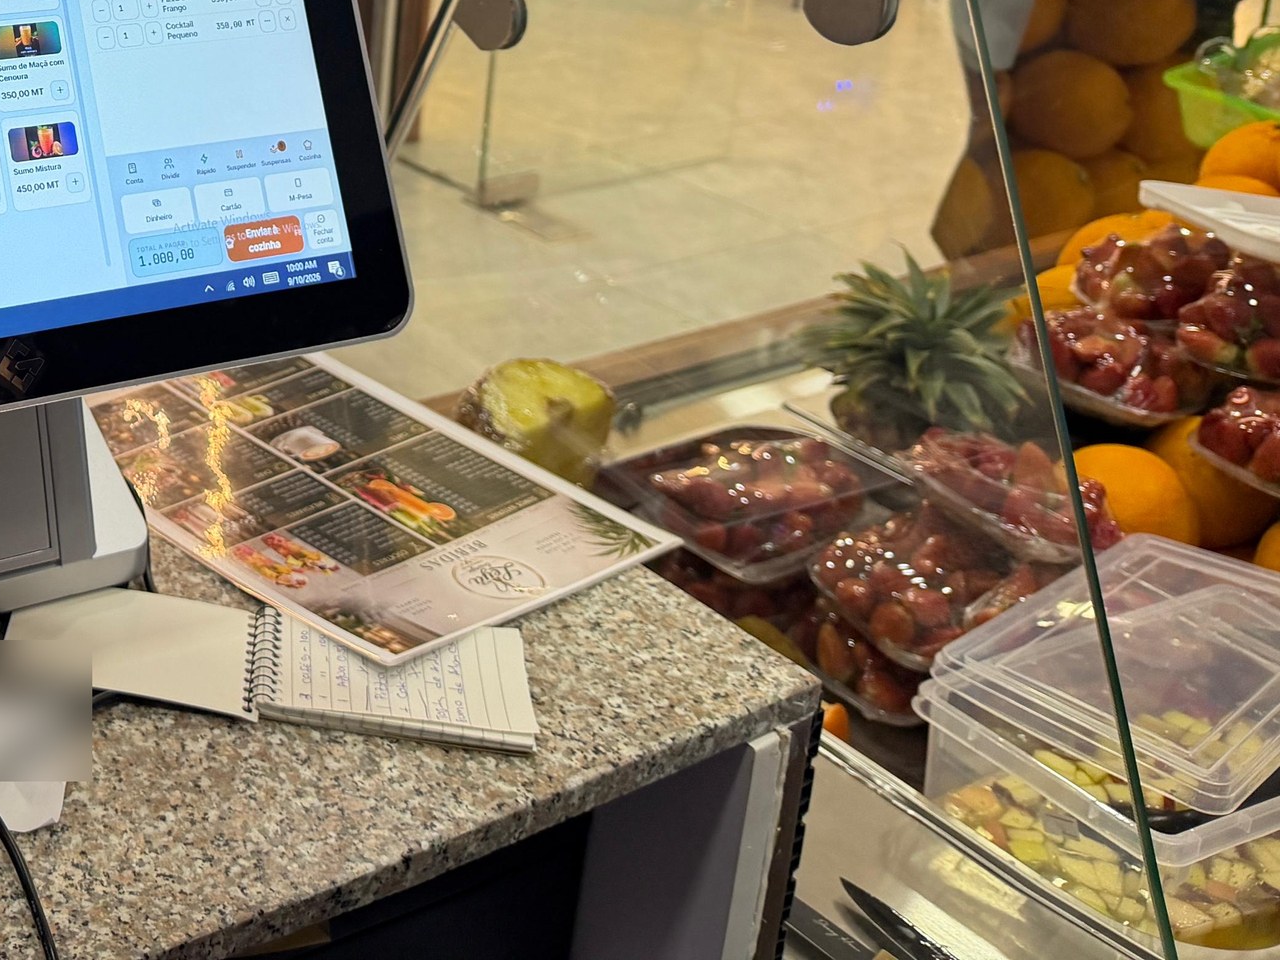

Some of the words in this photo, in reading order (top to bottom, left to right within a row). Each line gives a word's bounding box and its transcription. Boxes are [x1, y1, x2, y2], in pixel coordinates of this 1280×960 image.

[162, 5, 187, 13] Frango
[165, 21, 194, 30] Cocktail
[246, 19, 255, 27] MT
[167, 31, 198, 40] Pequeno
[299, 153, 321, 161] Cozinha
[13, 167, 34, 175] Sumo
[35, 163, 61, 173] Mistura
[196, 167, 216, 175] Rápido
[16, 184, 45, 194] 450,00
[46, 181, 59, 189] MT
[221, 202, 241, 211] Cartão
[146, 213, 172, 223] Dinheiro
[248, 240, 281, 253] cozinha
[139, 248, 194, 267] 1.000,00
[286, 262, 303, 272] 10:00
[304, 261, 317, 269] AM
[419, 539, 488, 571] BEBIDAS
